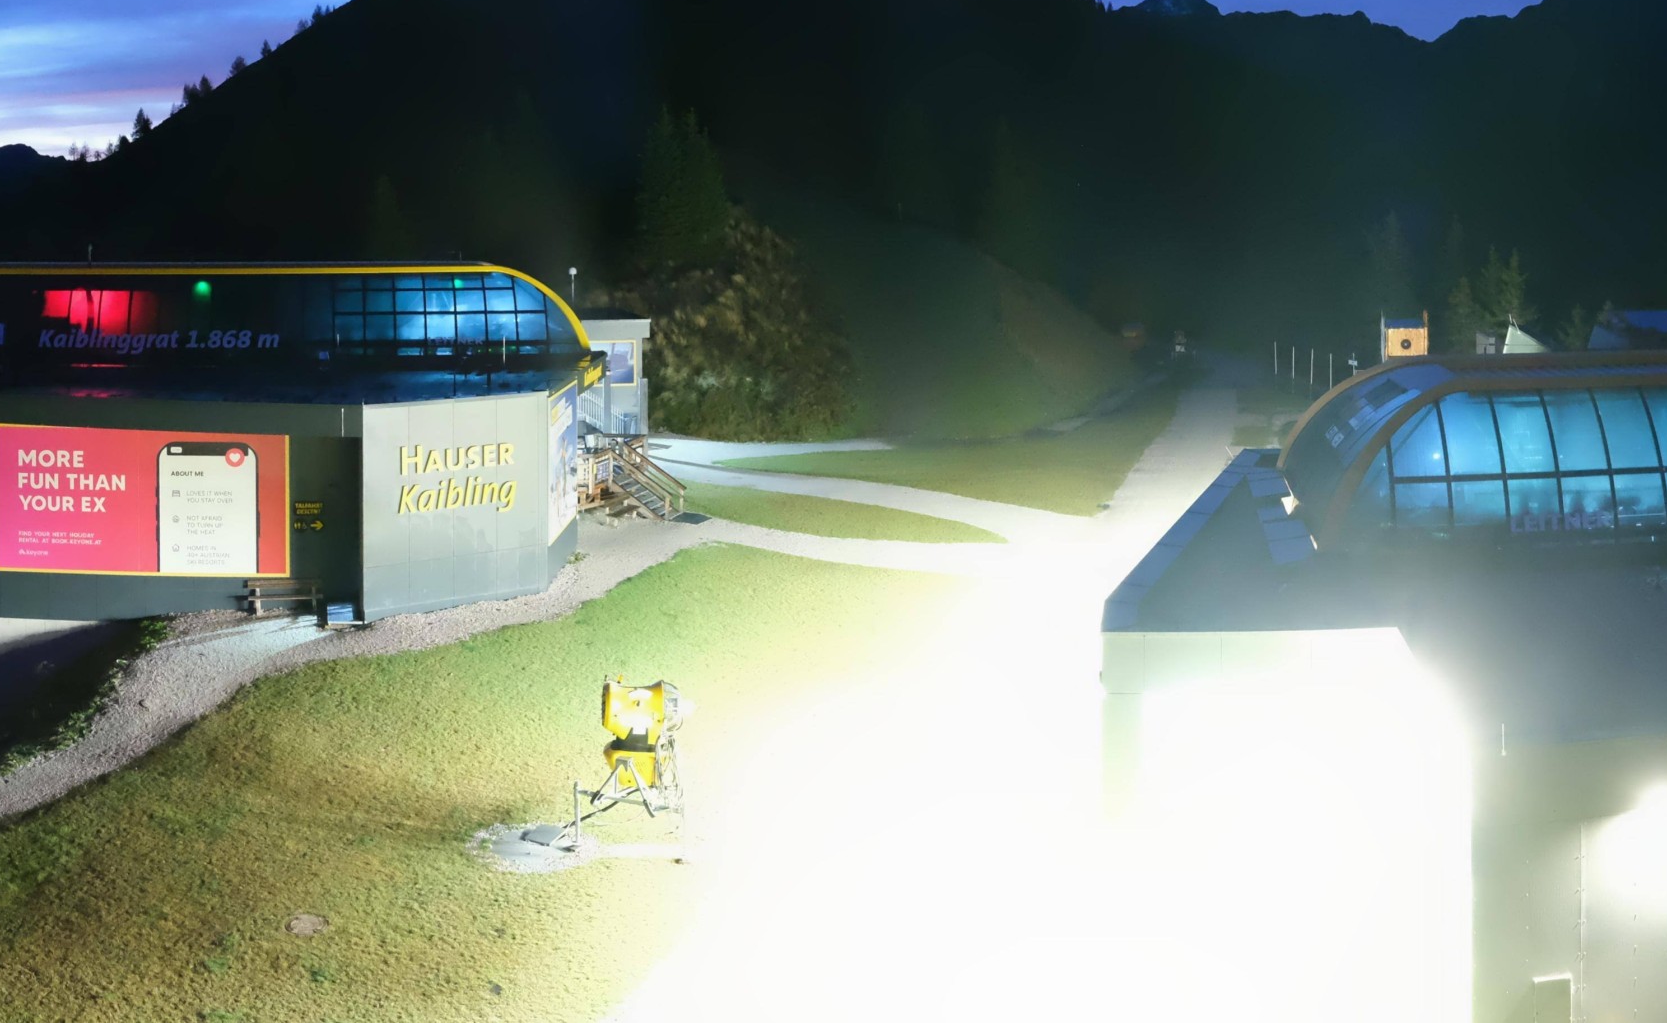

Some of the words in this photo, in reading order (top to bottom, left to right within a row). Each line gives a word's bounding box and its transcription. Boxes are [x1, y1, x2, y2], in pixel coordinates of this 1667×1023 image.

[38, 329, 180, 354] Kaiblinggrat
[185, 329, 252, 349] 1.868
[257, 334, 280, 348] m
[18, 449, 85, 468] MORE
[399, 442, 515, 476] HAUSER
[18, 472, 59, 489] FUN
[66, 473, 126, 491] THAN
[19, 495, 75, 512] YOUR
[81, 496, 106, 512] EX
[397, 476, 518, 514] Kaibling
